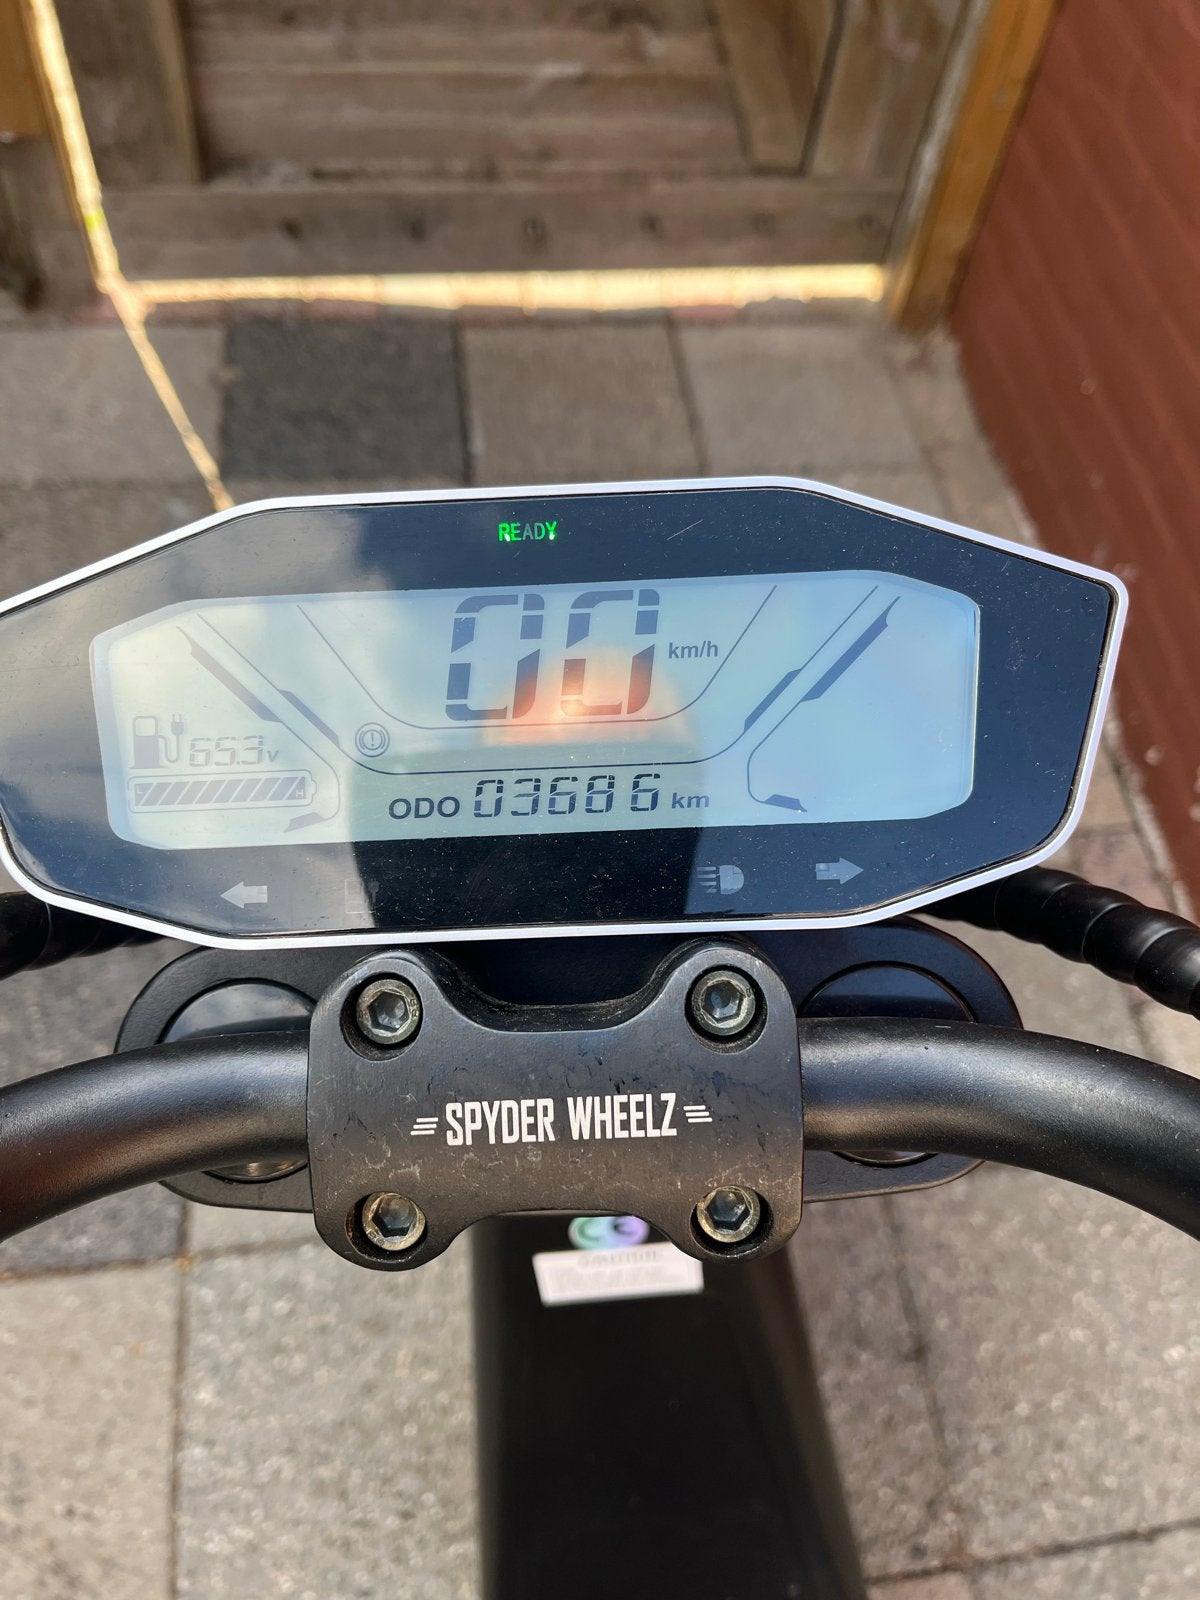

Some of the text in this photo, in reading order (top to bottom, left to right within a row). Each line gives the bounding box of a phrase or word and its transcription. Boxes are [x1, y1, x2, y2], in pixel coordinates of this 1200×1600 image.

[498, 521, 558, 542] READY
[445, 588, 719, 721] 00 km/h
[189, 734, 264, 768] 65.3
[388, 773, 710, 820] ODO 03686 km
[445, 1092, 678, 1146] SPYDER WHEELZ
